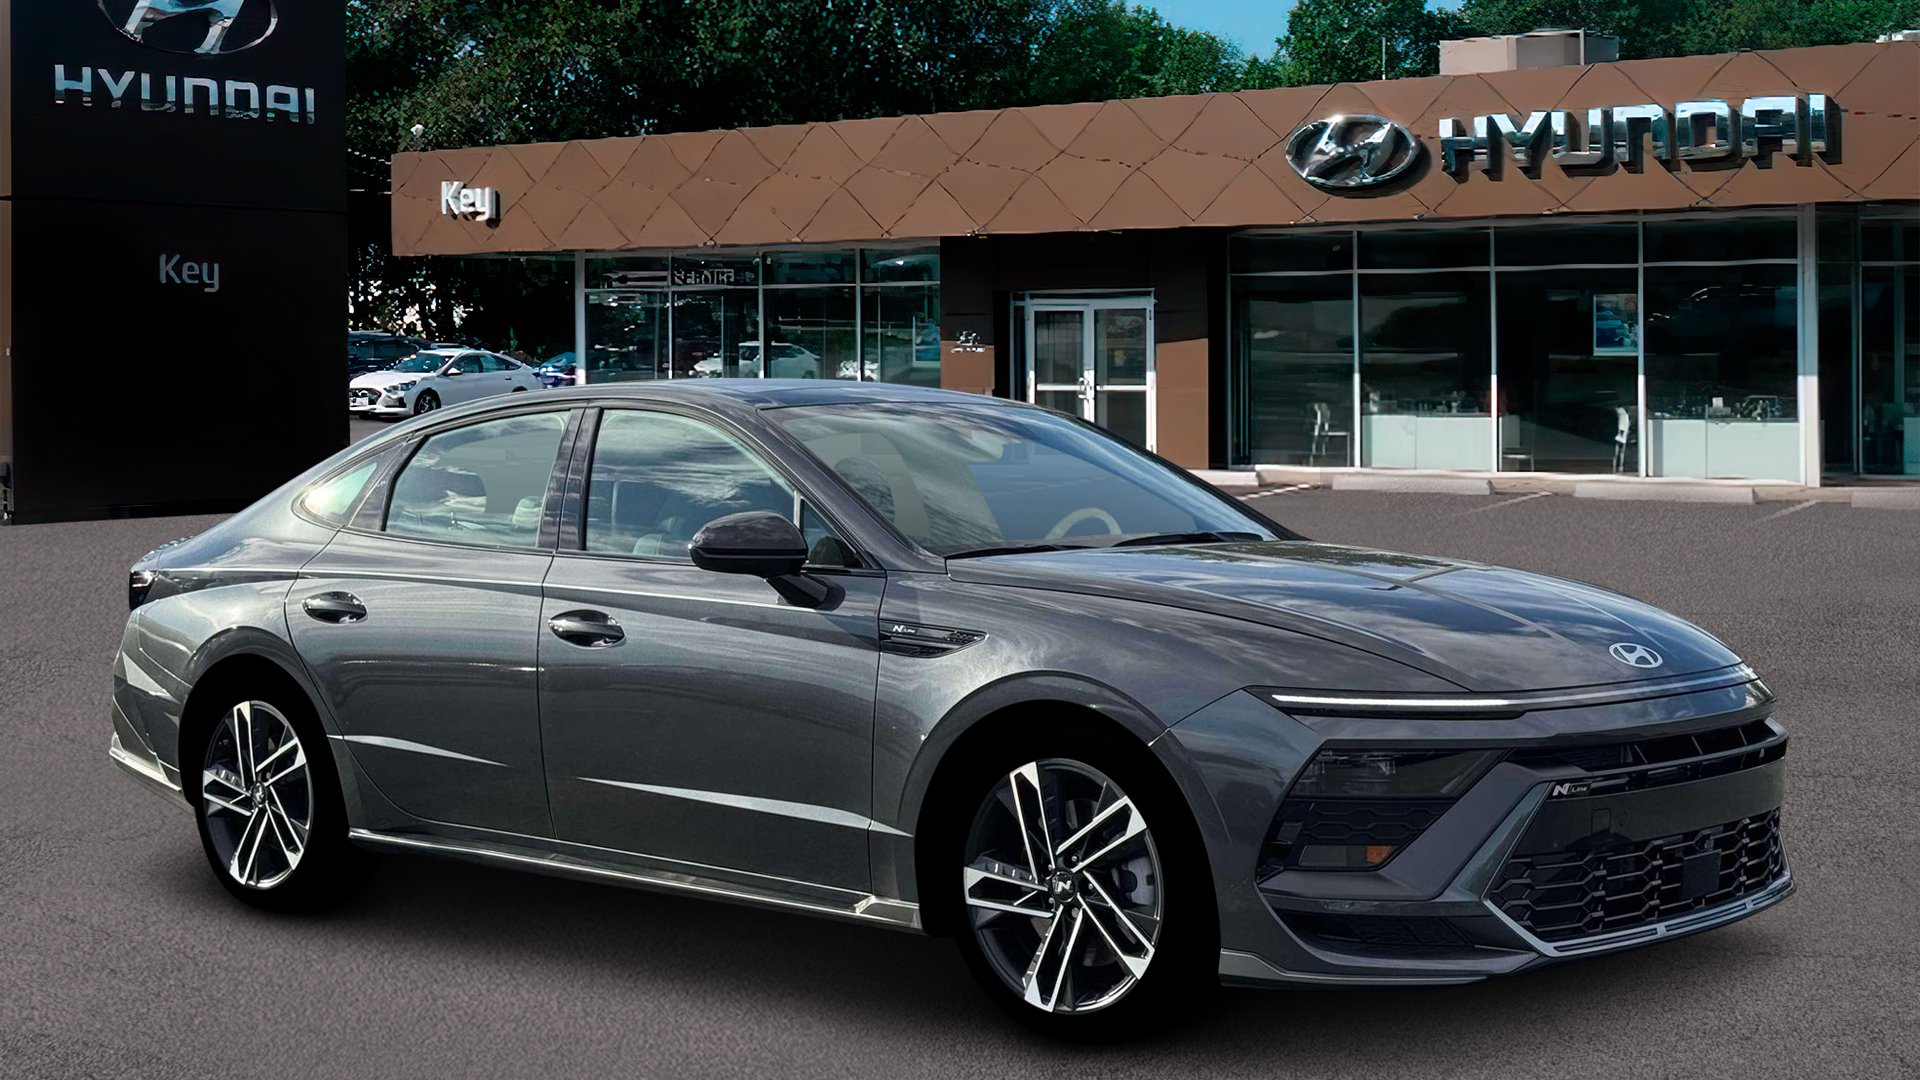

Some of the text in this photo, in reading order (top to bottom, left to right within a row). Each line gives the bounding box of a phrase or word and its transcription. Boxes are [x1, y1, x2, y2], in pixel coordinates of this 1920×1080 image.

[54, 64, 315, 125] HYUNDAI
[1438, 93, 1839, 182] HYUNDAI
[441, 180, 493, 222] Key
[159, 253, 220, 293] Key
